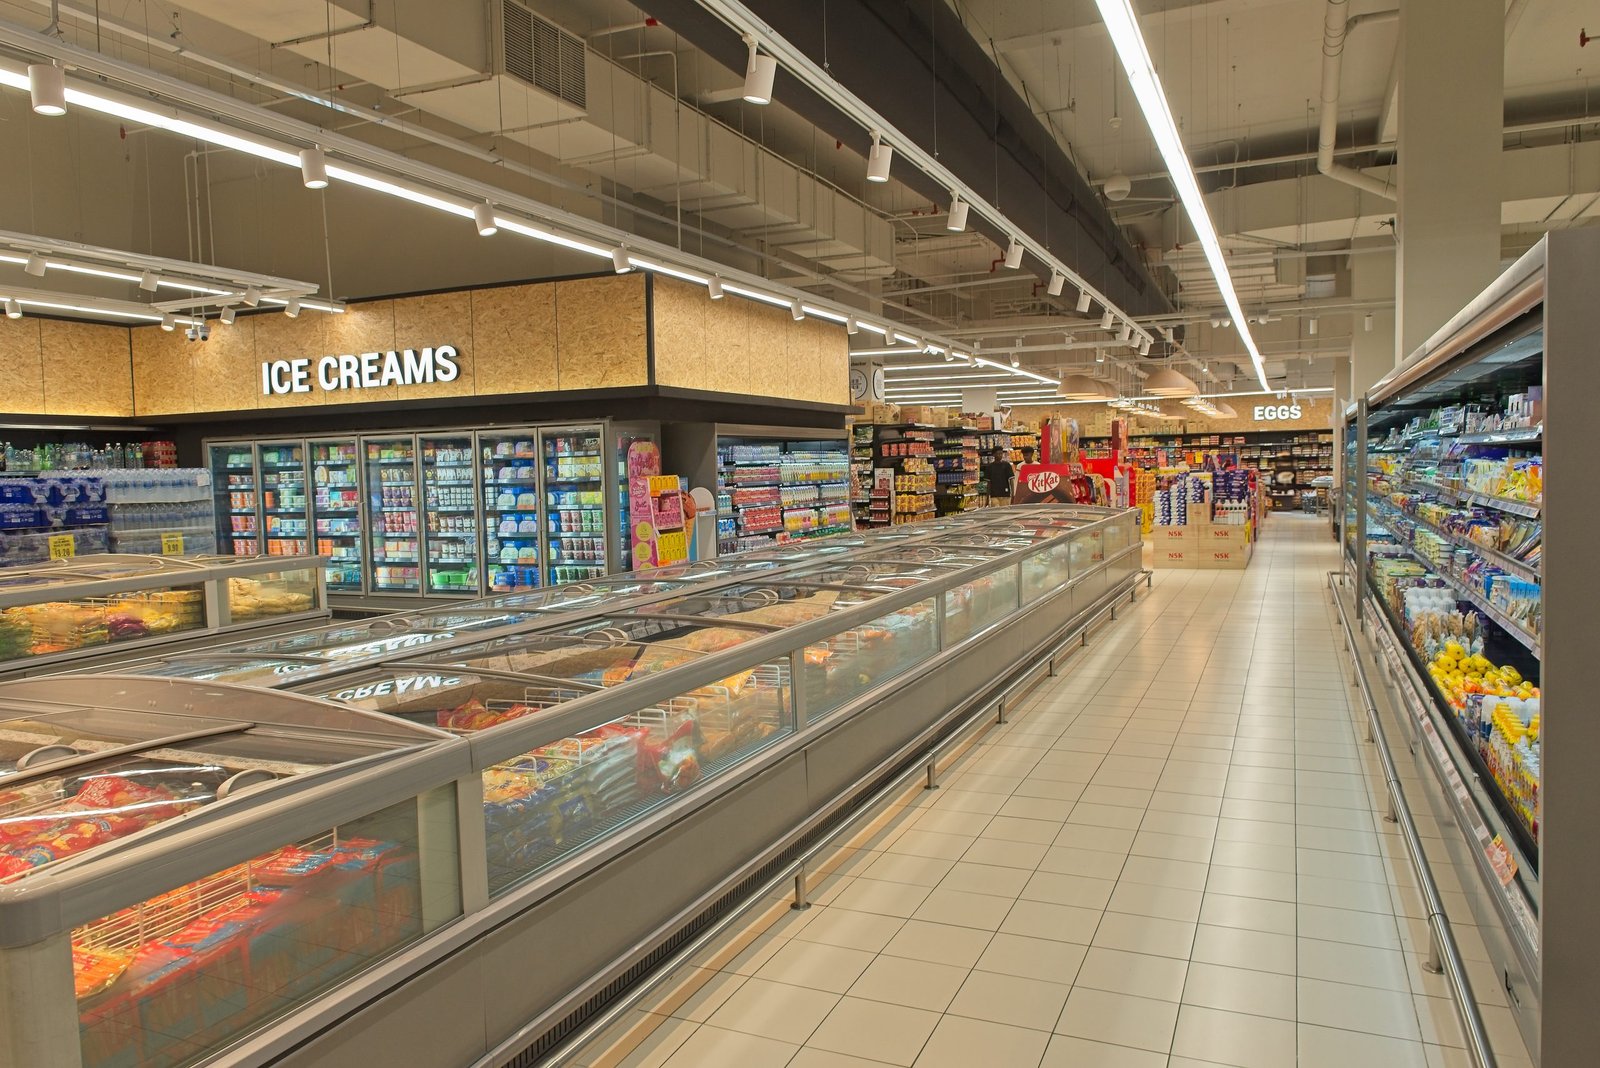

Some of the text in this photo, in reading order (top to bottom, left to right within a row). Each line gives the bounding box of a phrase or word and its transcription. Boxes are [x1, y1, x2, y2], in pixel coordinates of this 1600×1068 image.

[261, 345, 458, 394] ICE CREAMS
[1253, 404, 1302, 421] EGGS
[1031, 472, 1059, 491] KitKat
